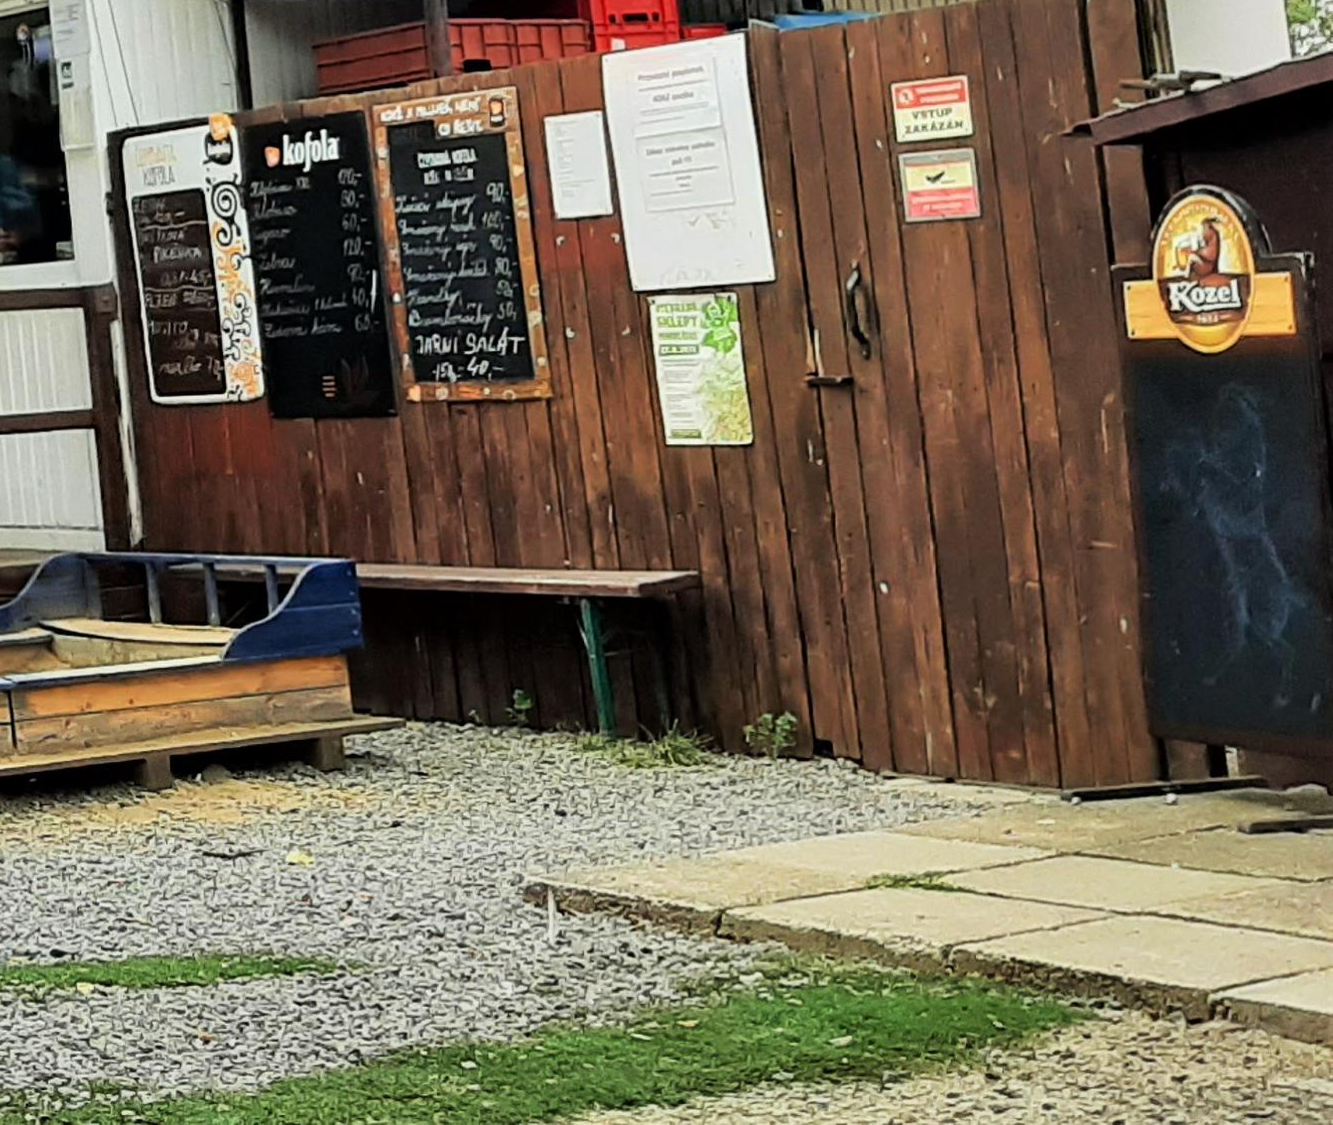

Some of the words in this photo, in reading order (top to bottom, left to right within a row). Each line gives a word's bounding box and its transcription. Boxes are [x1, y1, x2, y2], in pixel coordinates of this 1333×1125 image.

[905, 120, 963, 134] ZAKÁZÁN
[912, 107, 953, 119] VSTUP
[282, 129, 340, 173] kofola
[1169, 278, 1242, 312] Kozel
[464, 326, 525, 355] SALÁT
